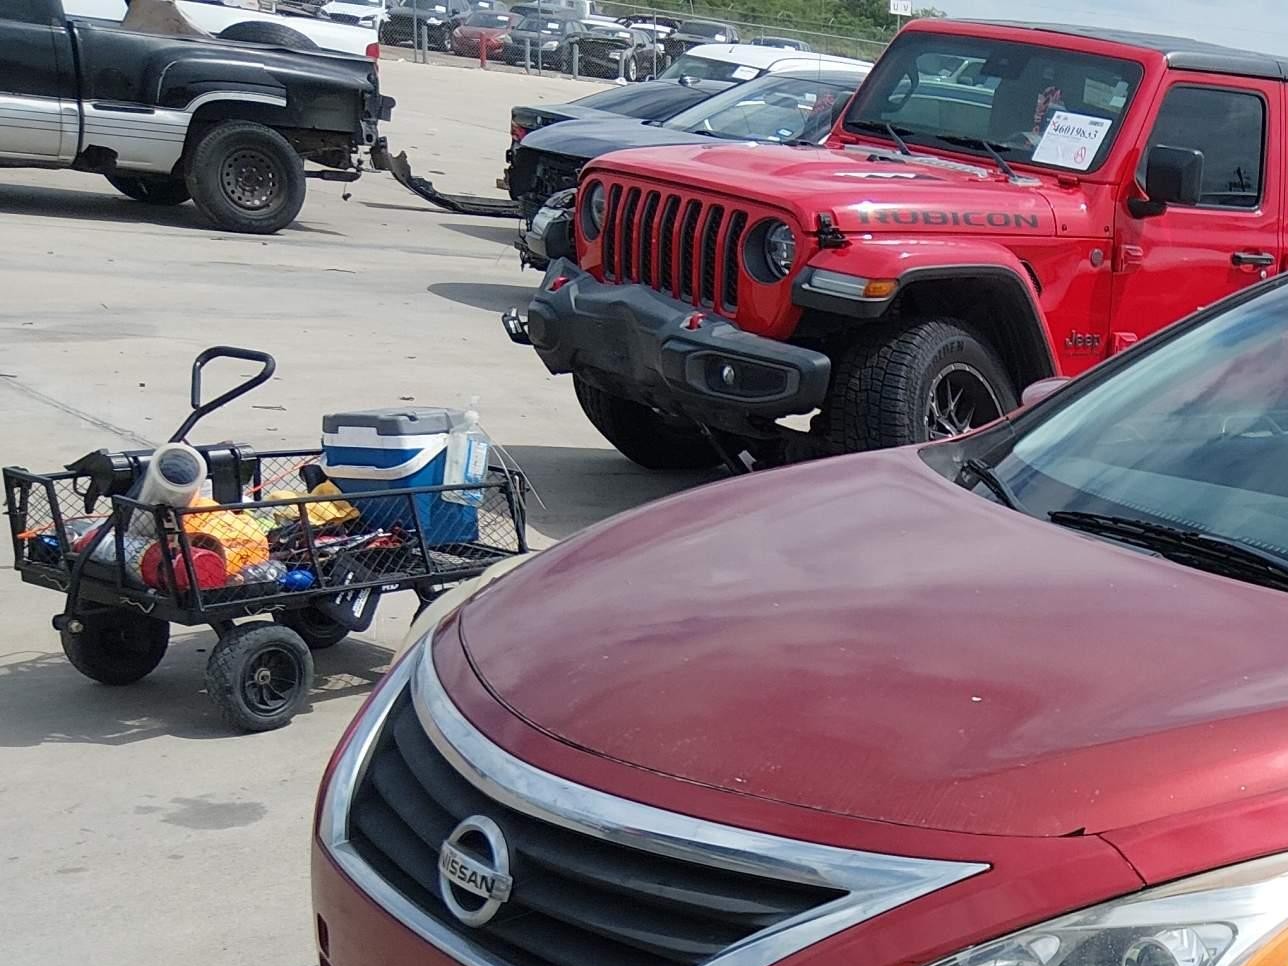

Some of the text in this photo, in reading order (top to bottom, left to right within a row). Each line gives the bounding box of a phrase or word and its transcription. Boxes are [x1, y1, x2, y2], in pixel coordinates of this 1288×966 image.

[859, 207, 1040, 229] RUBICON
[1065, 329, 1101, 353] Jeep
[442, 853, 496, 894] NISSAN
